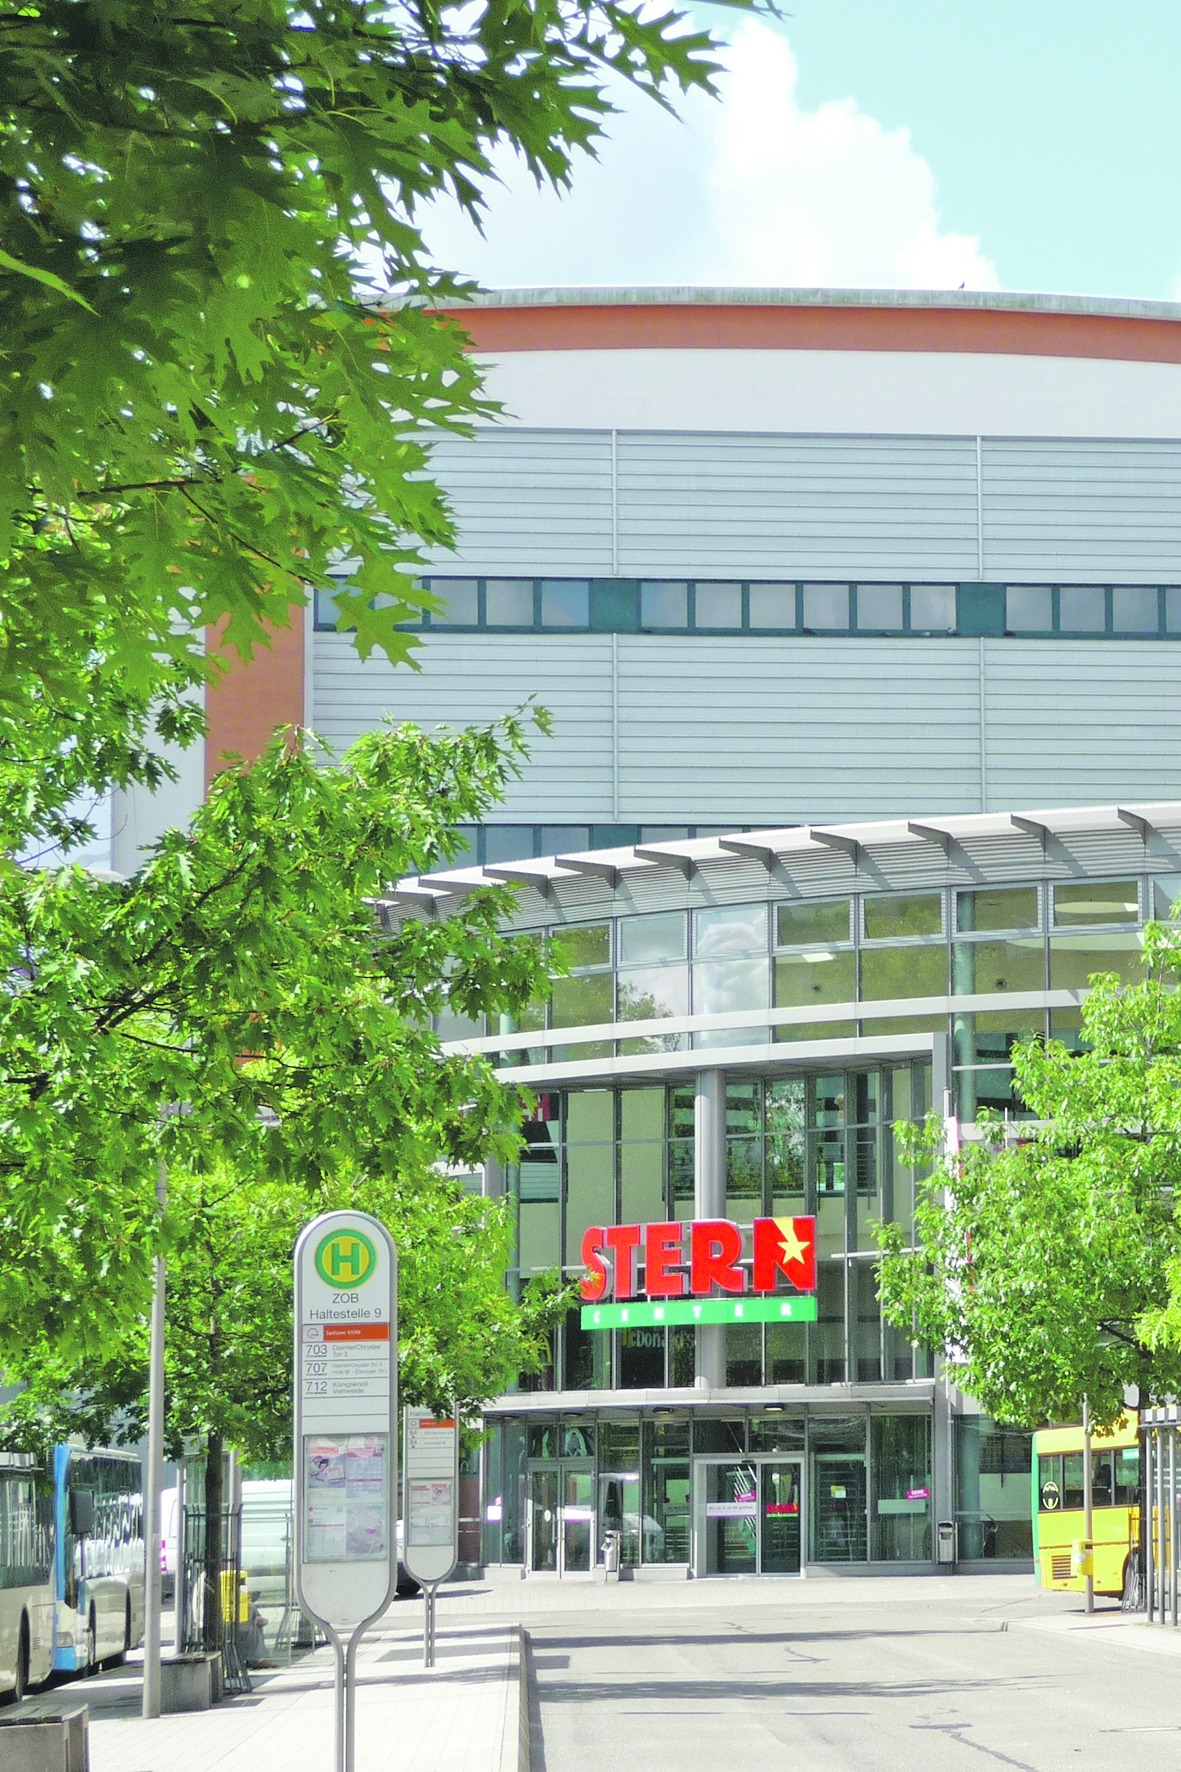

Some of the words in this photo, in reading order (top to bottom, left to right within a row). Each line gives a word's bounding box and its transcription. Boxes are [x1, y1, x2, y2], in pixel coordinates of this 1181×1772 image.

[580, 1215, 818, 1300] STERN
[332, 1292, 360, 1304] ZOB
[310, 1308, 371, 1320] Haltestelle
[374, 1307, 382, 1319] 9
[593, 1302, 793, 1325] CENTER
[622, 1327, 696, 1349] McDond's
[306, 1344, 328, 1355] 703
[306, 1363, 328, 1373] 707
[306, 1381, 328, 1392] 712
